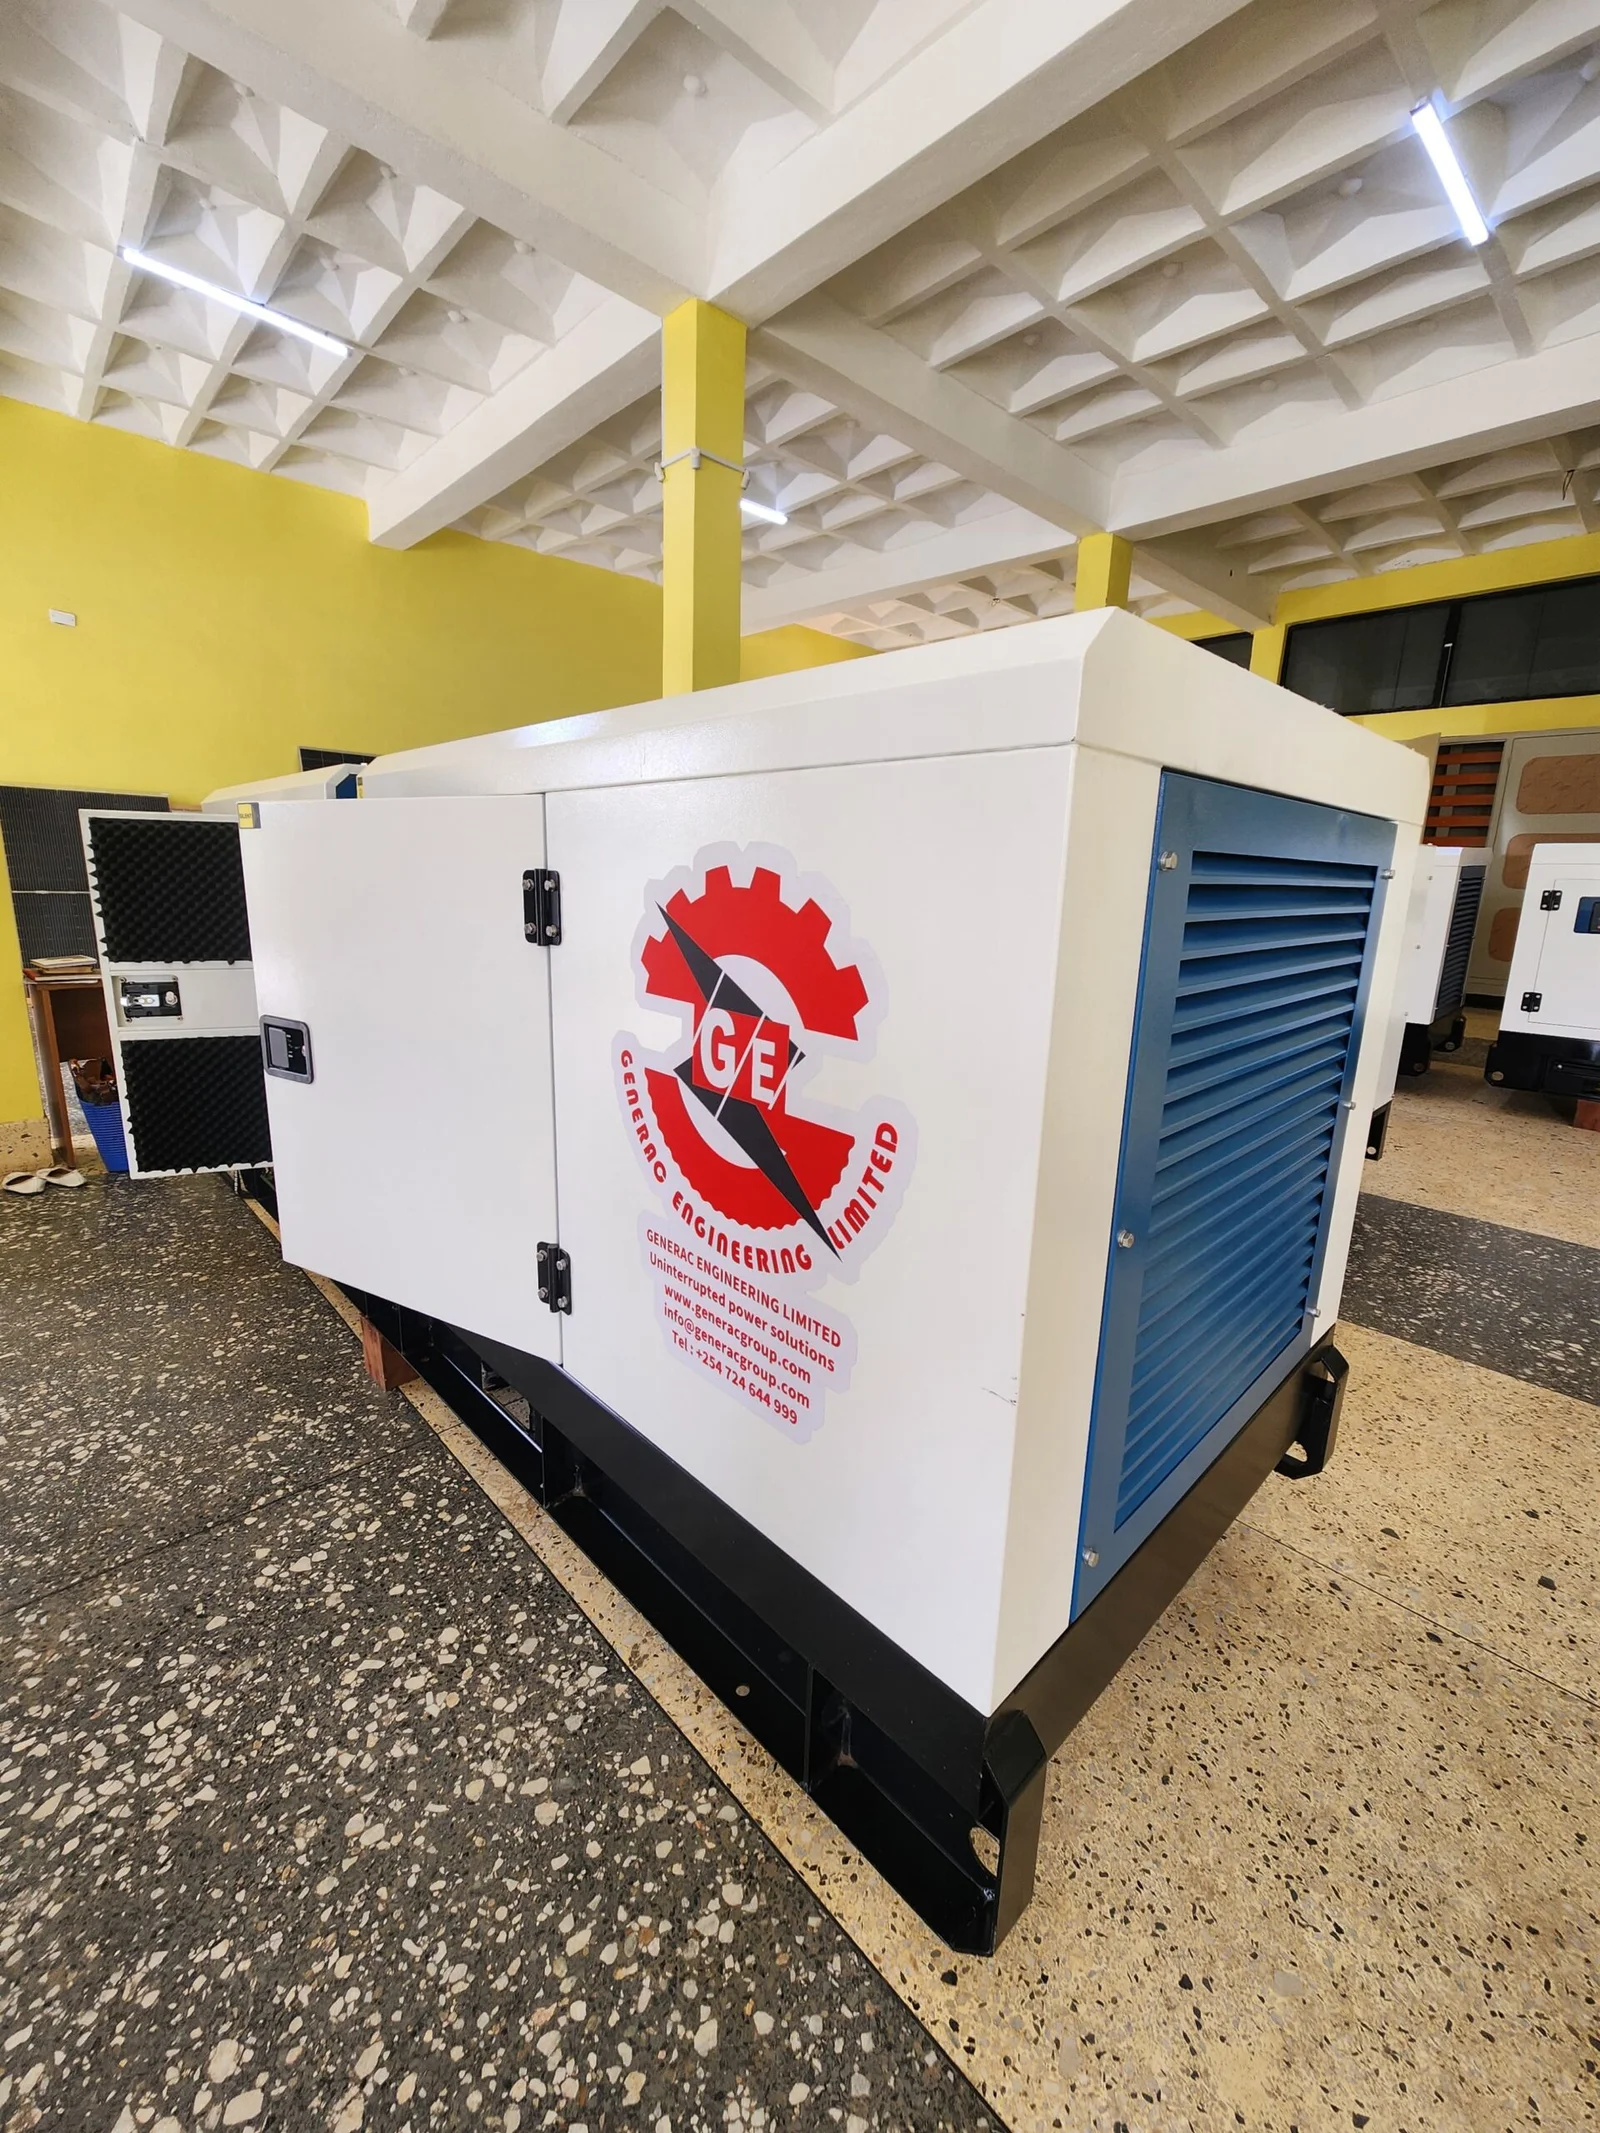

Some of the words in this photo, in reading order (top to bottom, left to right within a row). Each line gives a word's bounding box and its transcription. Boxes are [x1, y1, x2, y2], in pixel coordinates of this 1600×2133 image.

[619, 1048, 668, 1184] GENERAC
[671, 1190, 813, 1275] ENGINEERING
[827, 1120, 899, 1251] LIMITED
[646, 1228, 695, 1266] GENERAC
[696, 1255, 780, 1314] ENGINEERING
[783, 1303, 841, 1348] LIMITED
[649, 1251, 726, 1307] Uninterrupted
[728, 1299, 769, 1332] power
[770, 1324, 836, 1373] solutions
[664, 1283, 811, 1384] www.generacgroup.com
[663, 1302, 811, 1409] info@generacgroup.com
[696, 1348, 722, 1375] +254
[724, 1364, 747, 1391] 724
[748, 1381, 772, 1408] 644
[773, 1397, 798, 1425] 999
